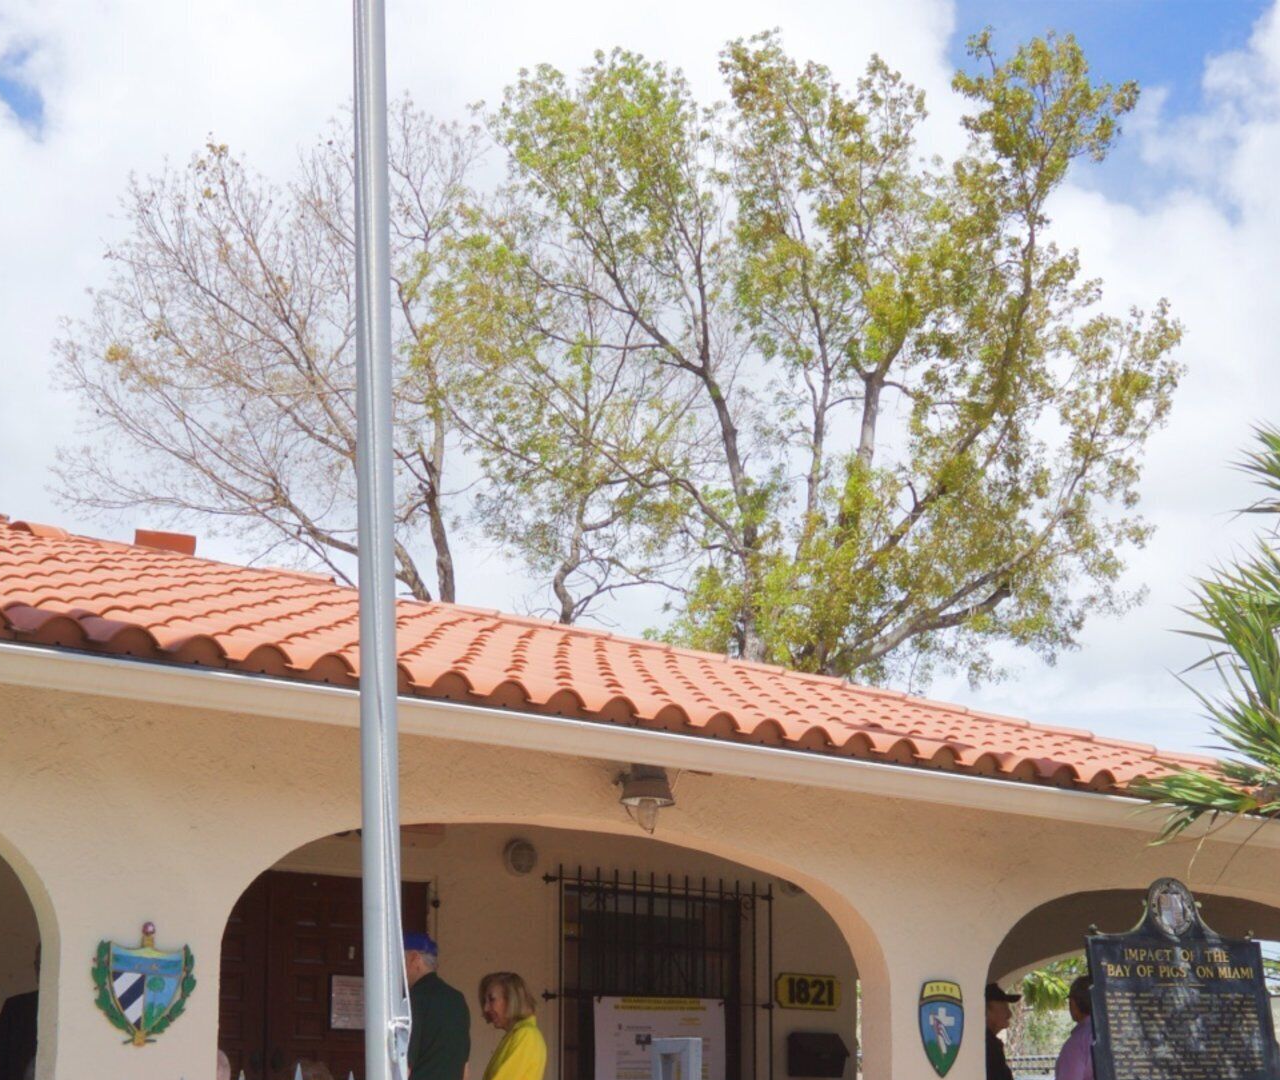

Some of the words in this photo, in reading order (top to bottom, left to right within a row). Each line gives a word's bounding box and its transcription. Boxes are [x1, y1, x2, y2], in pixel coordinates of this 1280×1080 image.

[1124, 949, 1171, 962] IMPACT
[1204, 951, 1230, 963] THE
[1136, 965, 1154, 977] OF
[1196, 967, 1214, 979] ON
[1218, 967, 1254, 979] MIAMI
[788, 977, 834, 1006] 1821
